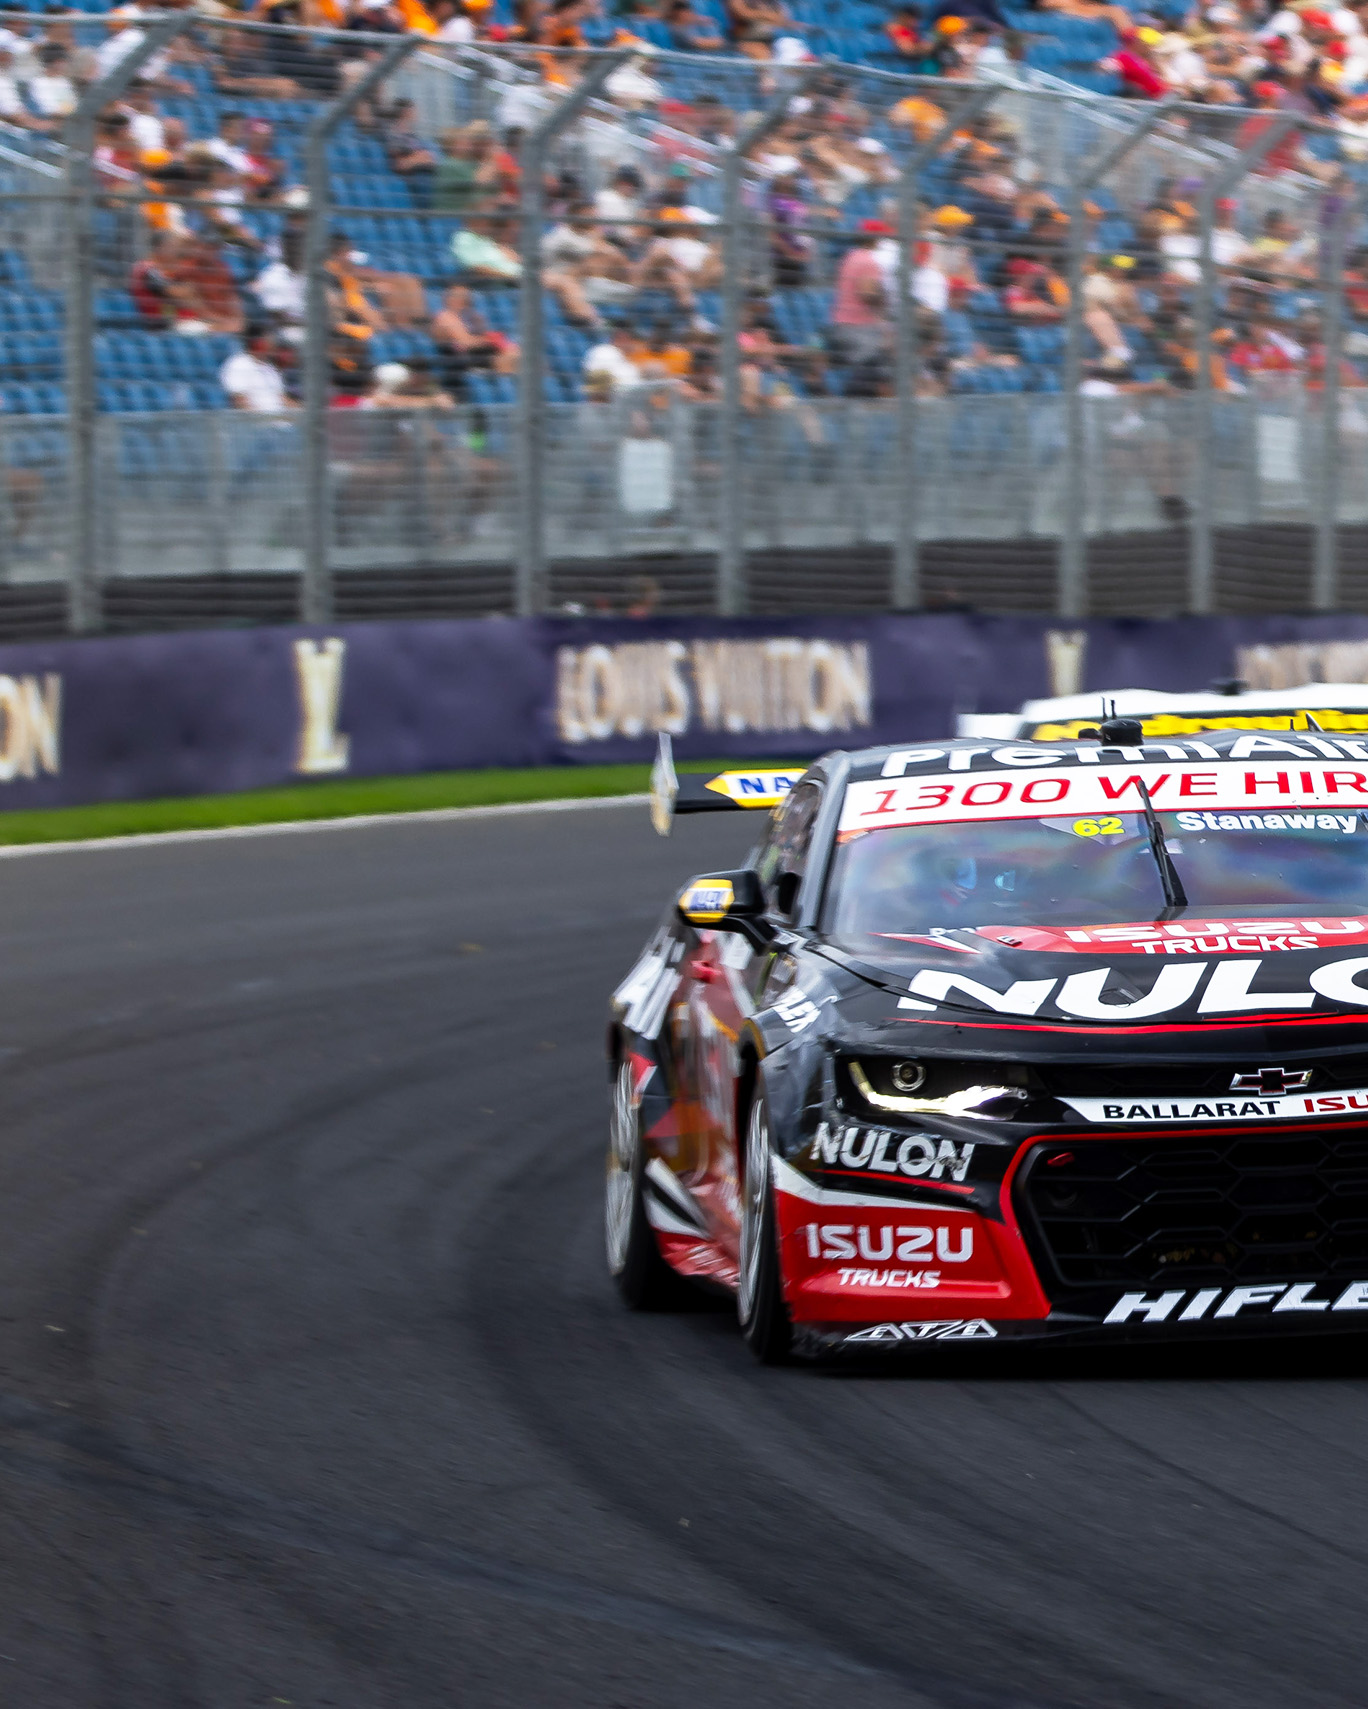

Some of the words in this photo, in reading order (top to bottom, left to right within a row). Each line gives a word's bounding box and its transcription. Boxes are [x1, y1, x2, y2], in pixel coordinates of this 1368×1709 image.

[859, 777, 1071, 816] 1300
[1097, 772, 1218, 799] WE
[1071, 816, 1125, 838] 62
[1176, 811, 1358, 834] Stanaway
[1063, 920, 1366, 943] ISUZU
[1131, 935, 1320, 955] TRUCKS
[1102, 1100, 1281, 1120] BALLARAT
[809, 1121, 976, 1182] NULON
[806, 1222, 974, 1263] ISUZU
[836, 1266, 942, 1289] TRUCKS
